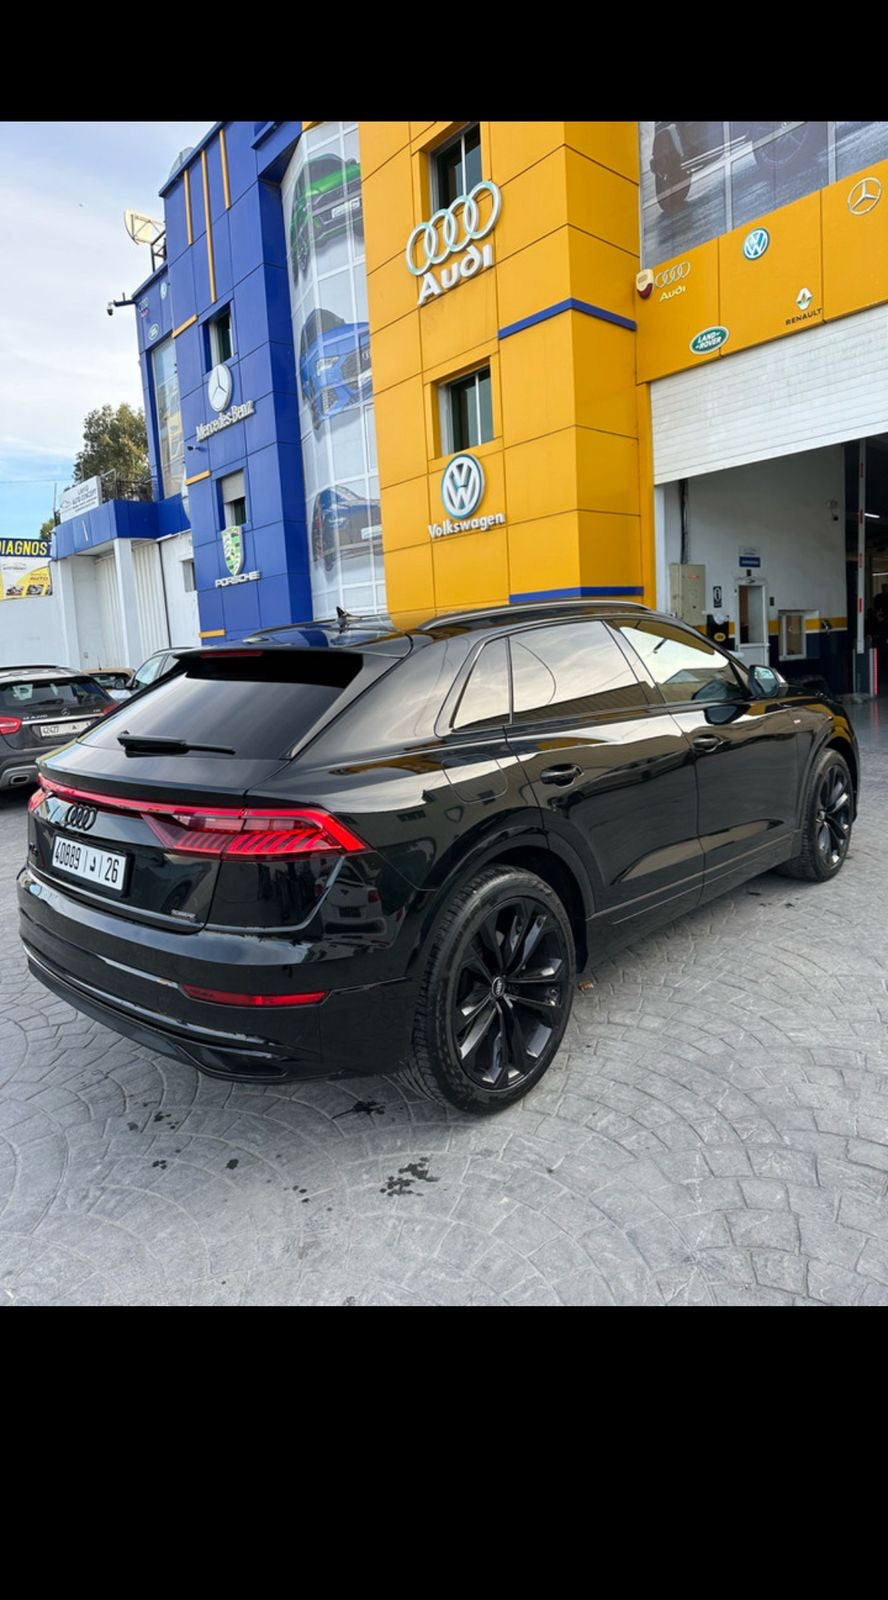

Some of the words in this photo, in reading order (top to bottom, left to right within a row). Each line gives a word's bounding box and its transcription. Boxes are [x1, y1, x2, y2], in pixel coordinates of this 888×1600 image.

[418, 243, 493, 306] Audi
[659, 285, 687, 302] Audi
[785, 307, 822, 326] RENAULT
[196, 400, 254, 442] Mercedes-Benz
[428, 512, 505, 538] Volkswagen
[215, 570, 260, 588] PORSCHE
[55, 840, 81, 870] 40889
[104, 857, 120, 884] 26
